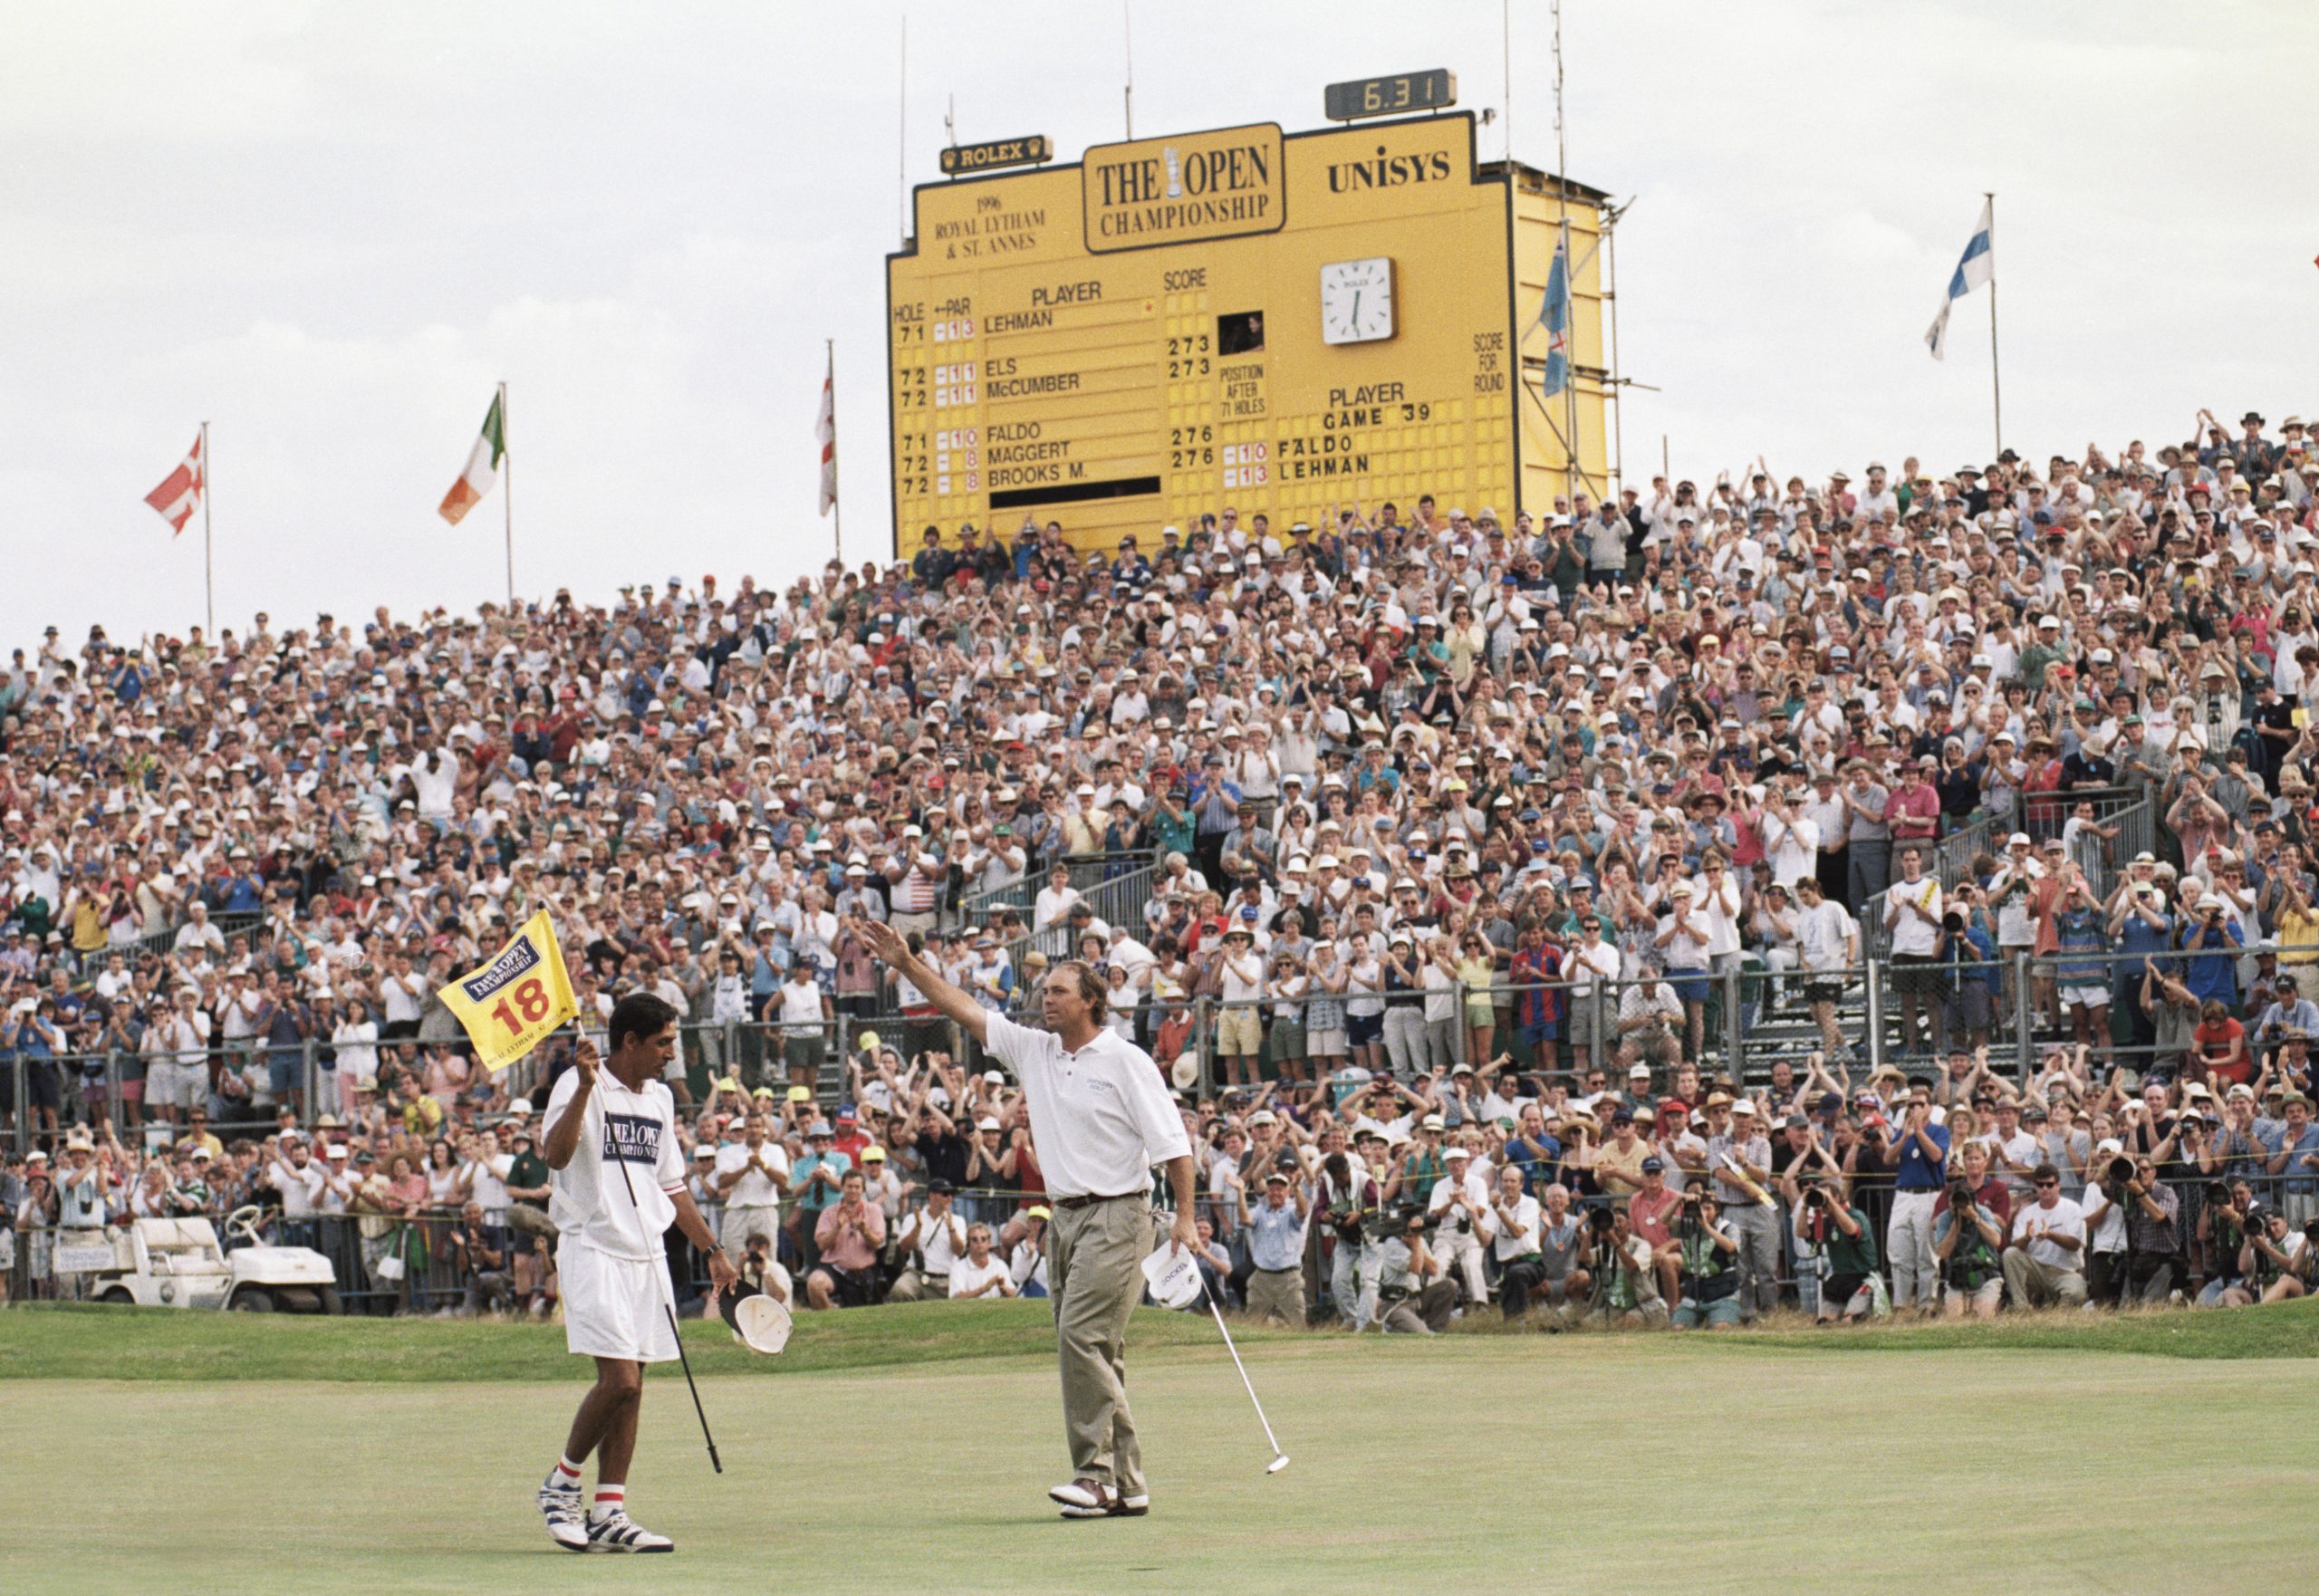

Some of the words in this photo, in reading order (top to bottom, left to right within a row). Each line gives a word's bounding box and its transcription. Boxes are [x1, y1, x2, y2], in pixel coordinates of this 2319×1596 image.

[1364, 77, 1433, 111] 6.31
[961, 142, 1024, 167] ROLEX
[1097, 159, 1160, 207] THE
[1185, 145, 1270, 197] OPEN
[936, 217, 979, 239] ROYAL
[985, 209, 1044, 233] LYTHAM
[1101, 193, 1269, 237] CHAMPIONSHIP
[947, 243, 957, 260] &
[989, 232, 1036, 254] ANNES
[1164, 268, 1207, 291] SCORE
[1033, 281, 1102, 306] PLAYER
[894, 303, 924, 322] HOLE
[985, 311, 1054, 334] LEHMAN
[1473, 332, 1504, 351] SCORE
[986, 358, 1016, 377] ELS
[1169, 336, 1209, 356] 273
[1479, 353, 1497, 372] FOR
[987, 372, 1080, 399] McCUMBER
[1169, 359, 1210, 378] 273
[1220, 364, 1264, 382] POSITION
[1475, 372, 1505, 392] ROUND
[1227, 382, 1257, 399] AFTER
[1330, 381, 1405, 408] PLAYER
[1235, 399, 1265, 415] HOLES
[1323, 408, 1382, 430] GAME
[1401, 403, 1430, 421] 39
[987, 422, 1041, 442] FALDO
[988, 441, 1071, 465] MAGGERT
[1171, 426, 1212, 446] 276
[1278, 434, 1352, 457] FALDO
[988, 465, 1060, 487] BROOKS
[1172, 447, 1214, 468] 276
[1280, 456, 1369, 480] LEHMAN
[470, 971, 497, 993] THE
[499, 942, 529, 970] OPEN
[478, 955, 532, 995] CHAMPIONSHIP
[492, 978, 550, 1037] 18
